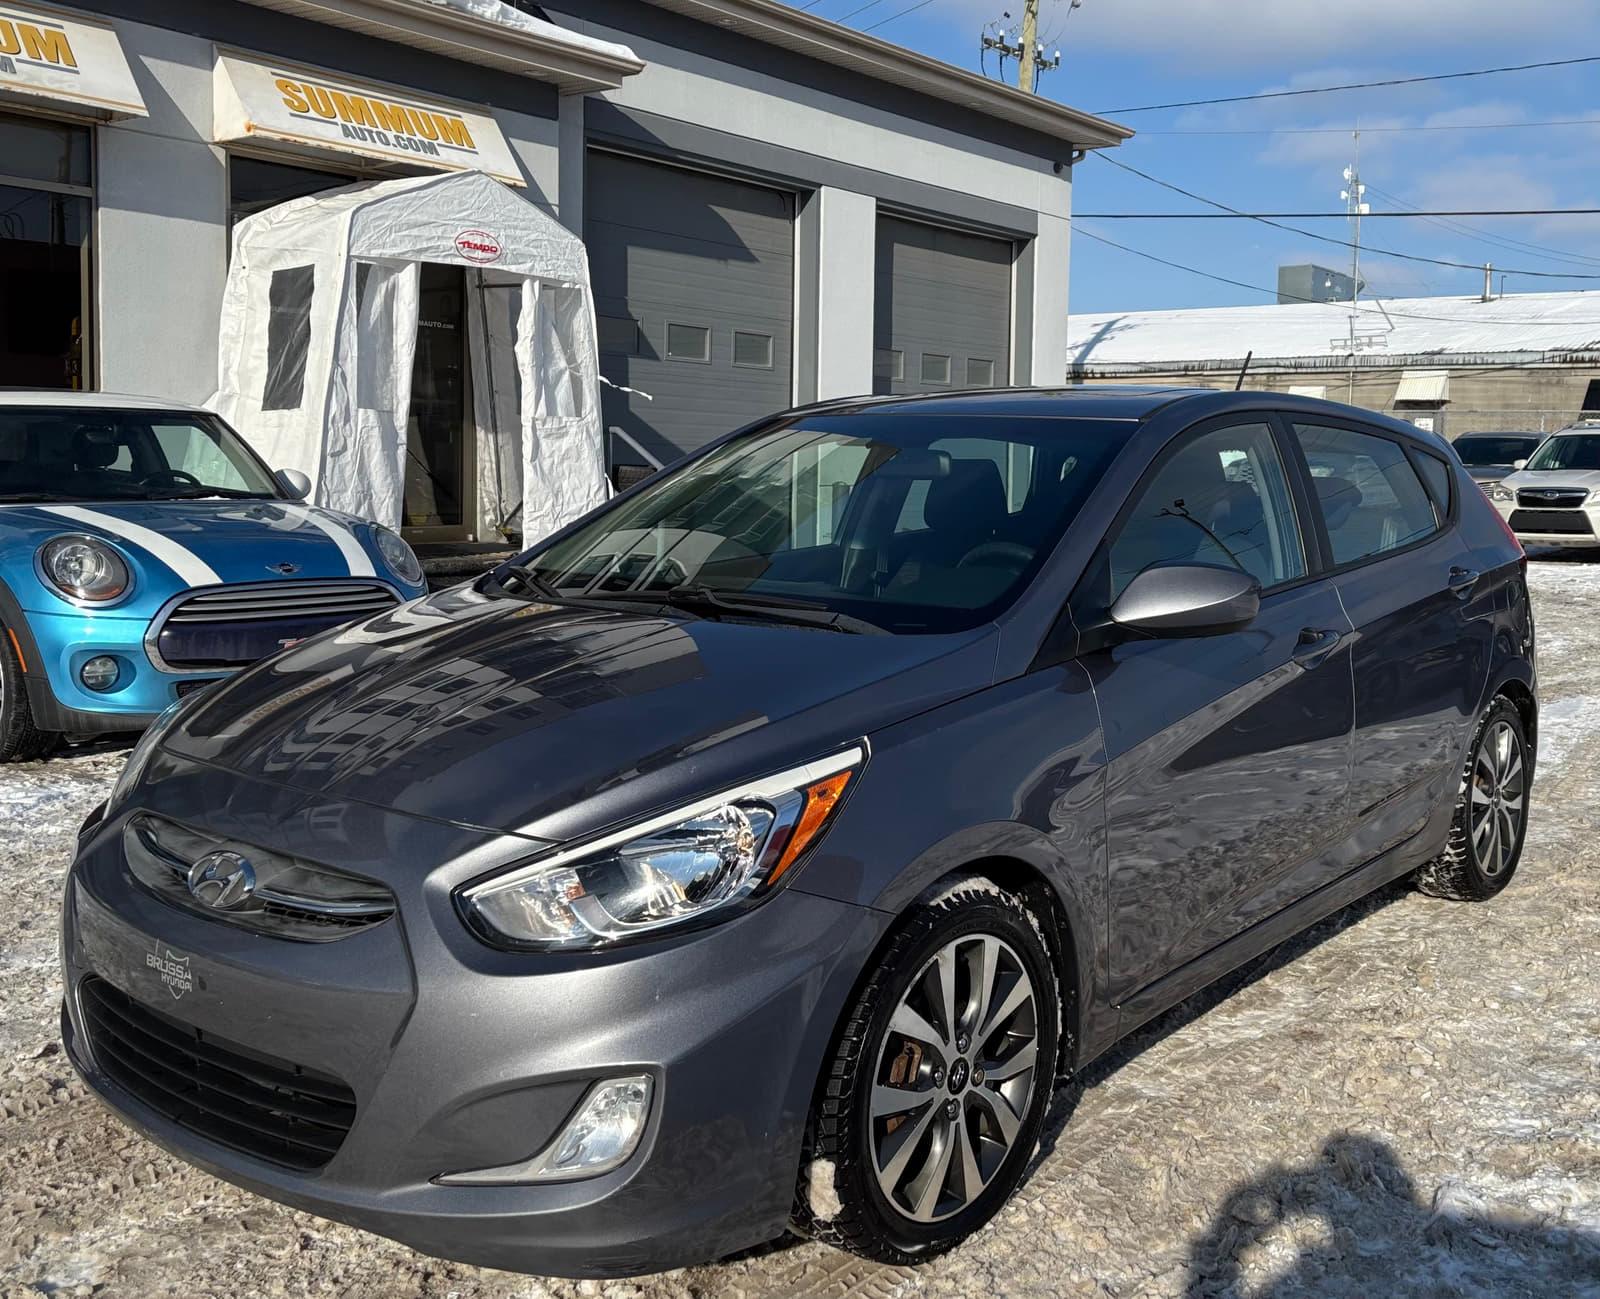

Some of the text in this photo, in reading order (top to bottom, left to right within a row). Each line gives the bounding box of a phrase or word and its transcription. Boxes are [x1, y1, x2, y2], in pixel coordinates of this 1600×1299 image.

[275, 79, 476, 149] SUMMUM
[340, 123, 440, 156] AUTO.COM
[458, 240, 498, 253] TEMPO
